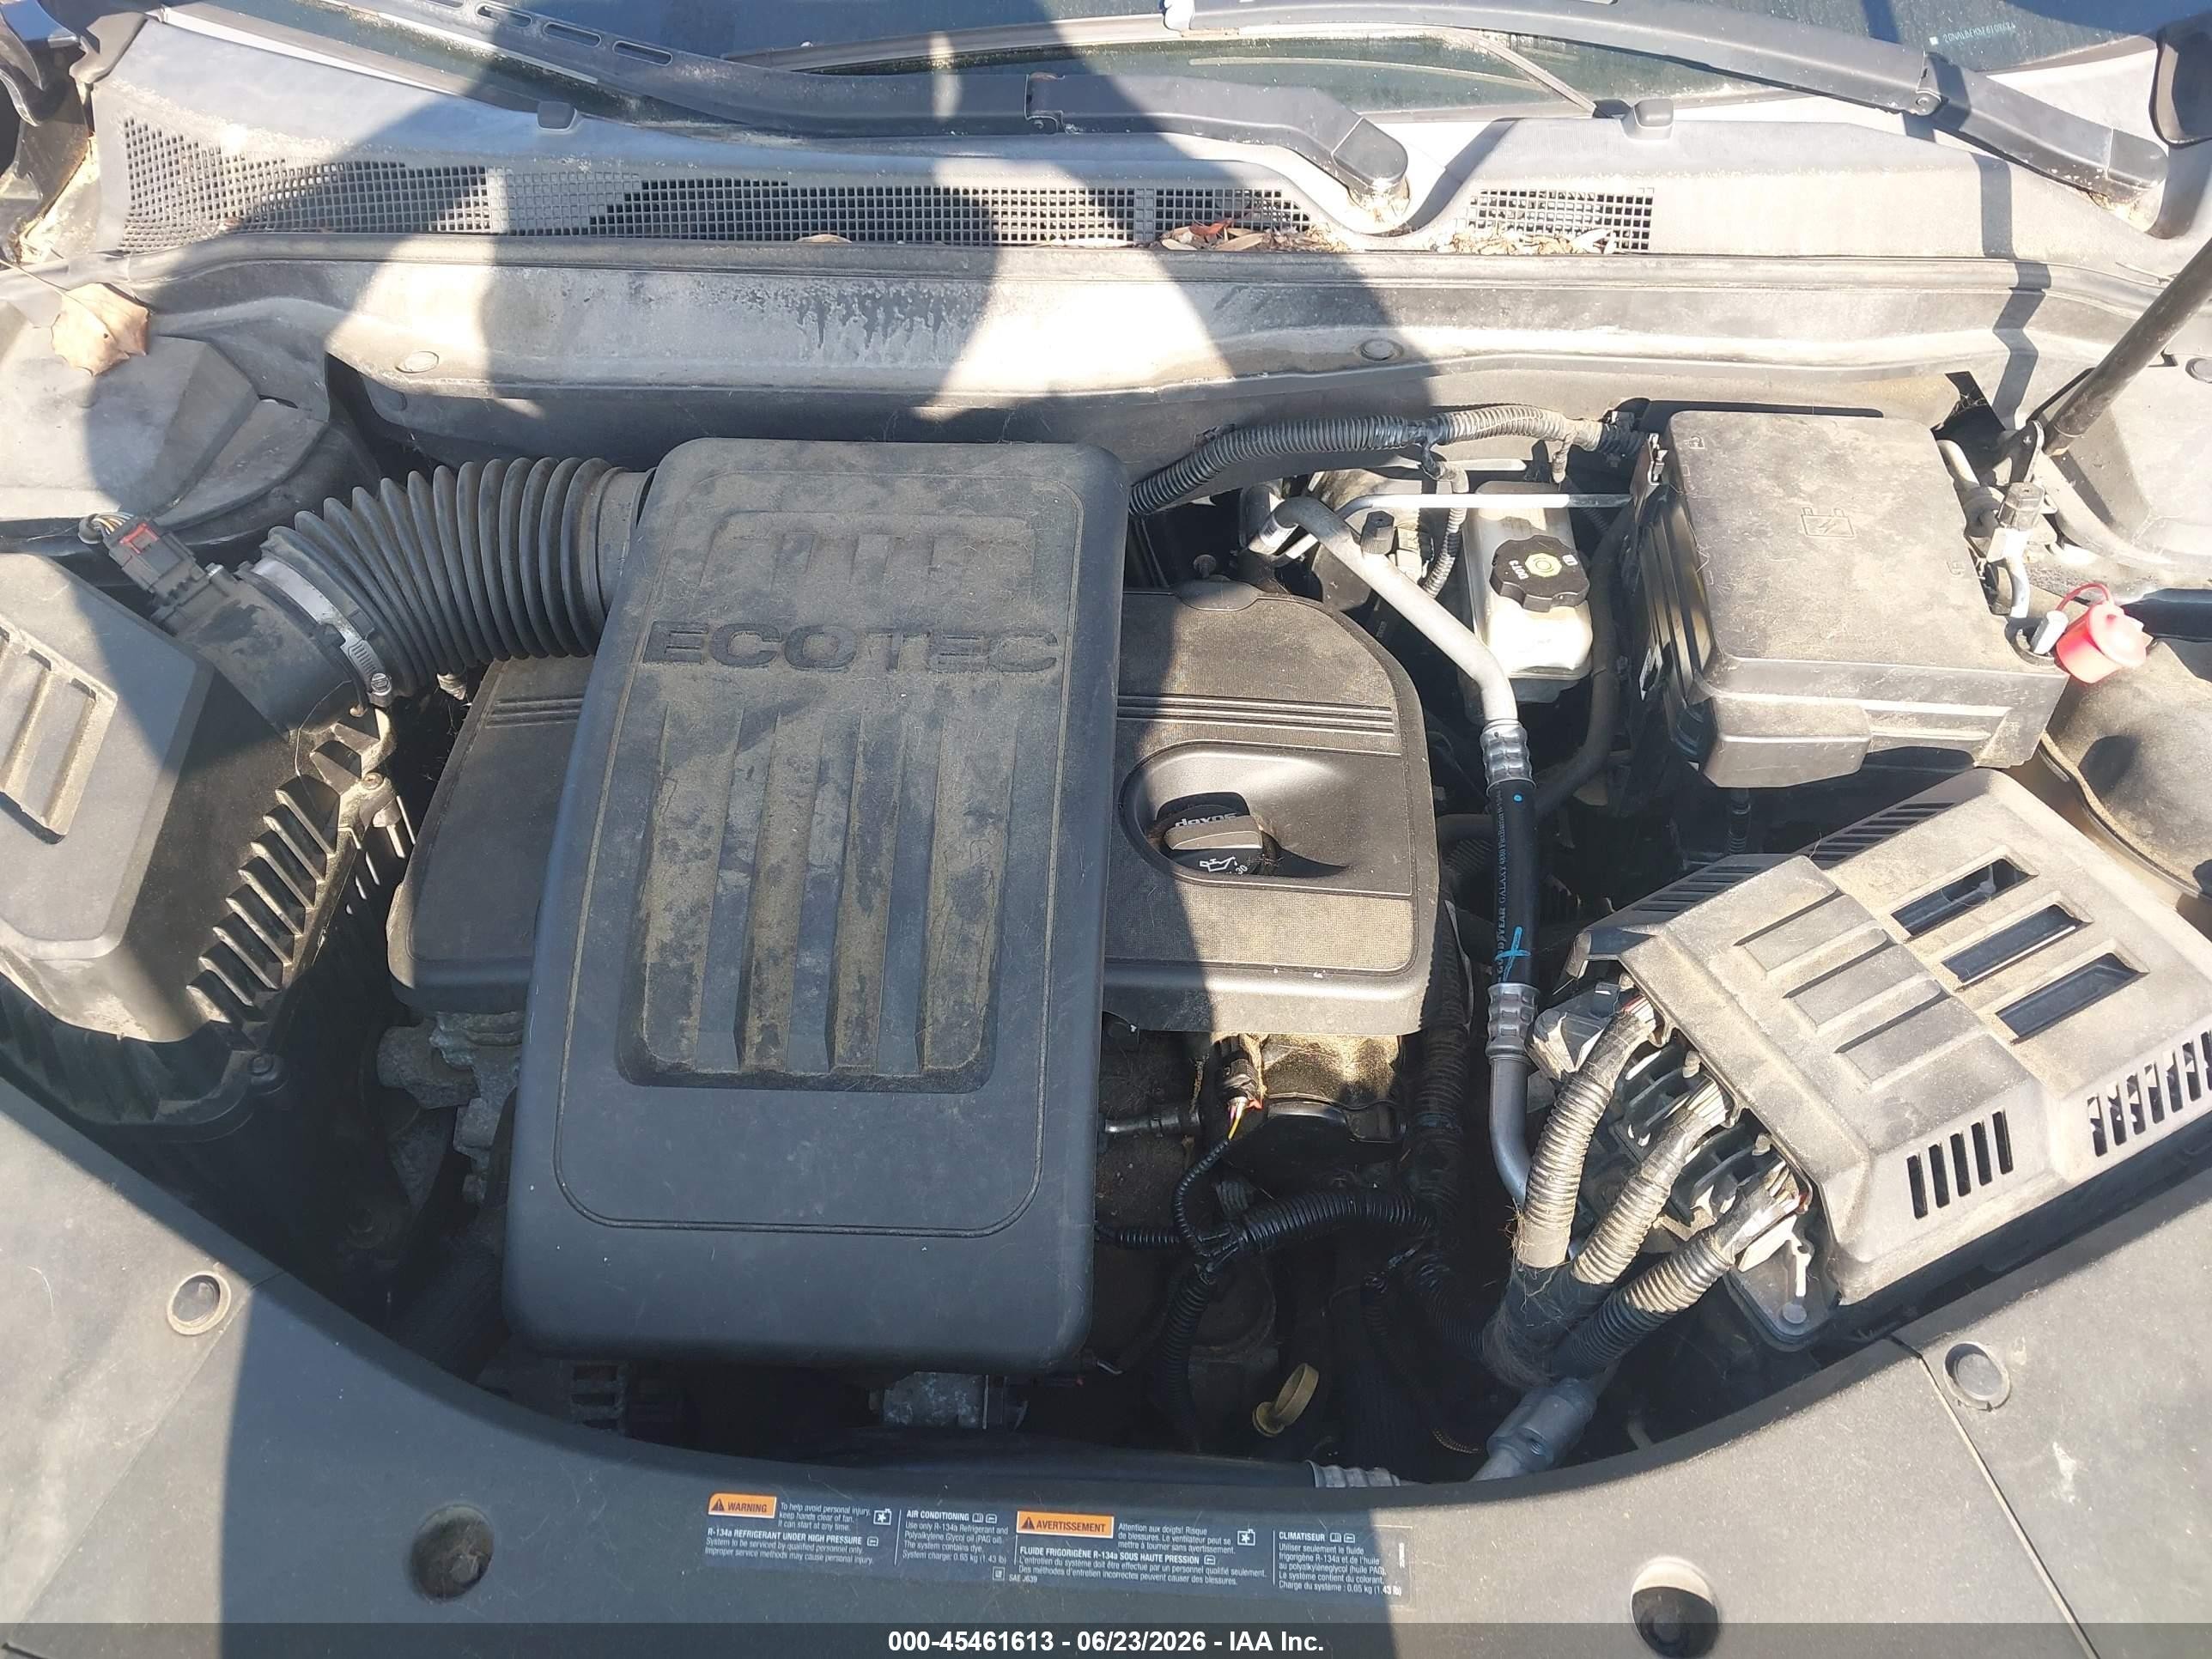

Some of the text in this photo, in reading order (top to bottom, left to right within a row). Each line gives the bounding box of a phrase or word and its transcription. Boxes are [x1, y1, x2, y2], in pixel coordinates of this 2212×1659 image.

[642, 621, 1059, 672] ECOTEC
[727, 1502, 767, 1513] WARNING
[781, 1502, 787, 1510] To
[789, 1503, 803, 1512] help
[823, 1505, 850, 1514] personal
[779, 1512, 794, 1521] keep
[817, 1513, 832, 1522] clear
[907, 1510, 969, 1522] AIR CONDITIONING
[821, 1523, 833, 1532] any
[919, 1522, 933, 1531] only
[934, 1522, 958, 1532] R-134a
[959, 1524, 995, 1534] Refrigerant
[996, 1526, 1008, 1535] and
[1036, 1520, 1106, 1533] AVERTISSEMENT
[1118, 1523, 1147, 1533] Attention
[1162, 1525, 1183, 1535] doigts!
[1185, 1527, 1207, 1536] Risque
[708, 1528, 862, 1546] R-134a REFRIGERANT UNDER HIGH PRESSURE
[905, 1530, 945, 1540] Polyalkylene
[945, 1533, 965, 1542] Glycol
[966, 1534, 975, 1542] oil
[975, 1534, 991, 1544] (PAG
[1127, 1532, 1160, 1541] blessures.
[1172, 1534, 1206, 1544] ventilateur
[1207, 1537, 1221, 1546] peut
[1279, 1531, 1325, 1542] CLIMATISEUR
[706, 1536, 730, 1547] System
[749, 1540, 776, 1549] serviced
[777, 1541, 785, 1551] by
[787, 1541, 815, 1552] qualified
[816, 1545, 848, 1554] personnel
[904, 1540, 915, 1548] The
[917, 1540, 939, 1550] system
[941, 1542, 969, 1552] contains
[1118, 1540, 1236, 1554] mettre à tourner sans avertissement.
[1279, 1543, 1364, 1555] Utiliser seulement le fluide
[705, 1547, 733, 1557] Improper
[759, 1550, 788, 1559] methods
[790, 1553, 803, 1561] may
[824, 1554, 854, 1563] personal
[902, 1549, 927, 1559] System
[927, 1552, 951, 1562] charge:
[969, 1554, 978, 1563] kg
[1020, 1547, 1200, 1565] FLUIDE FRIGORIGÈNE R-134a SOUS HAUTE PRESSION
[1279, 1553, 1314, 1563] frigorigène
[1316, 1554, 1340, 1563] R-134a
[1350, 1556, 1358, 1565] de
[1359, 1556, 1380, 1565] l'huile
[1054, 1557, 1063, 1566] du
[1064, 1559, 1093, 1569] système
[1093, 1559, 1105, 1568] doit
[1107, 1560, 1120, 1570] être
[1149, 1564, 1160, 1573] par
[1171, 1565, 1204, 1574] personnel
[1349, 1565, 1367, 1575] (huile
[1018, 1565, 1031, 1574] Des
[1032, 1566, 1065, 1577] méthodes
[1066, 1568, 1101, 1578] d'entretien
[1103, 1570, 1139, 1580] incorrectes
[1140, 1572, 1166, 1582] peuvent
[1192, 1575, 1203, 1583] des
[1289, 1571, 1316, 1582] système
[1317, 1573, 1344, 1582] contient
[1346, 1574, 1354, 1583] du
[1279, 1580, 1302, 1590] Charge
[1304, 1581, 1312, 1590] du
[1314, 1582, 1341, 1592] système
[1364, 1585, 1372, 1595] kg
[1393, 1585, 1401, 1596] lb)
